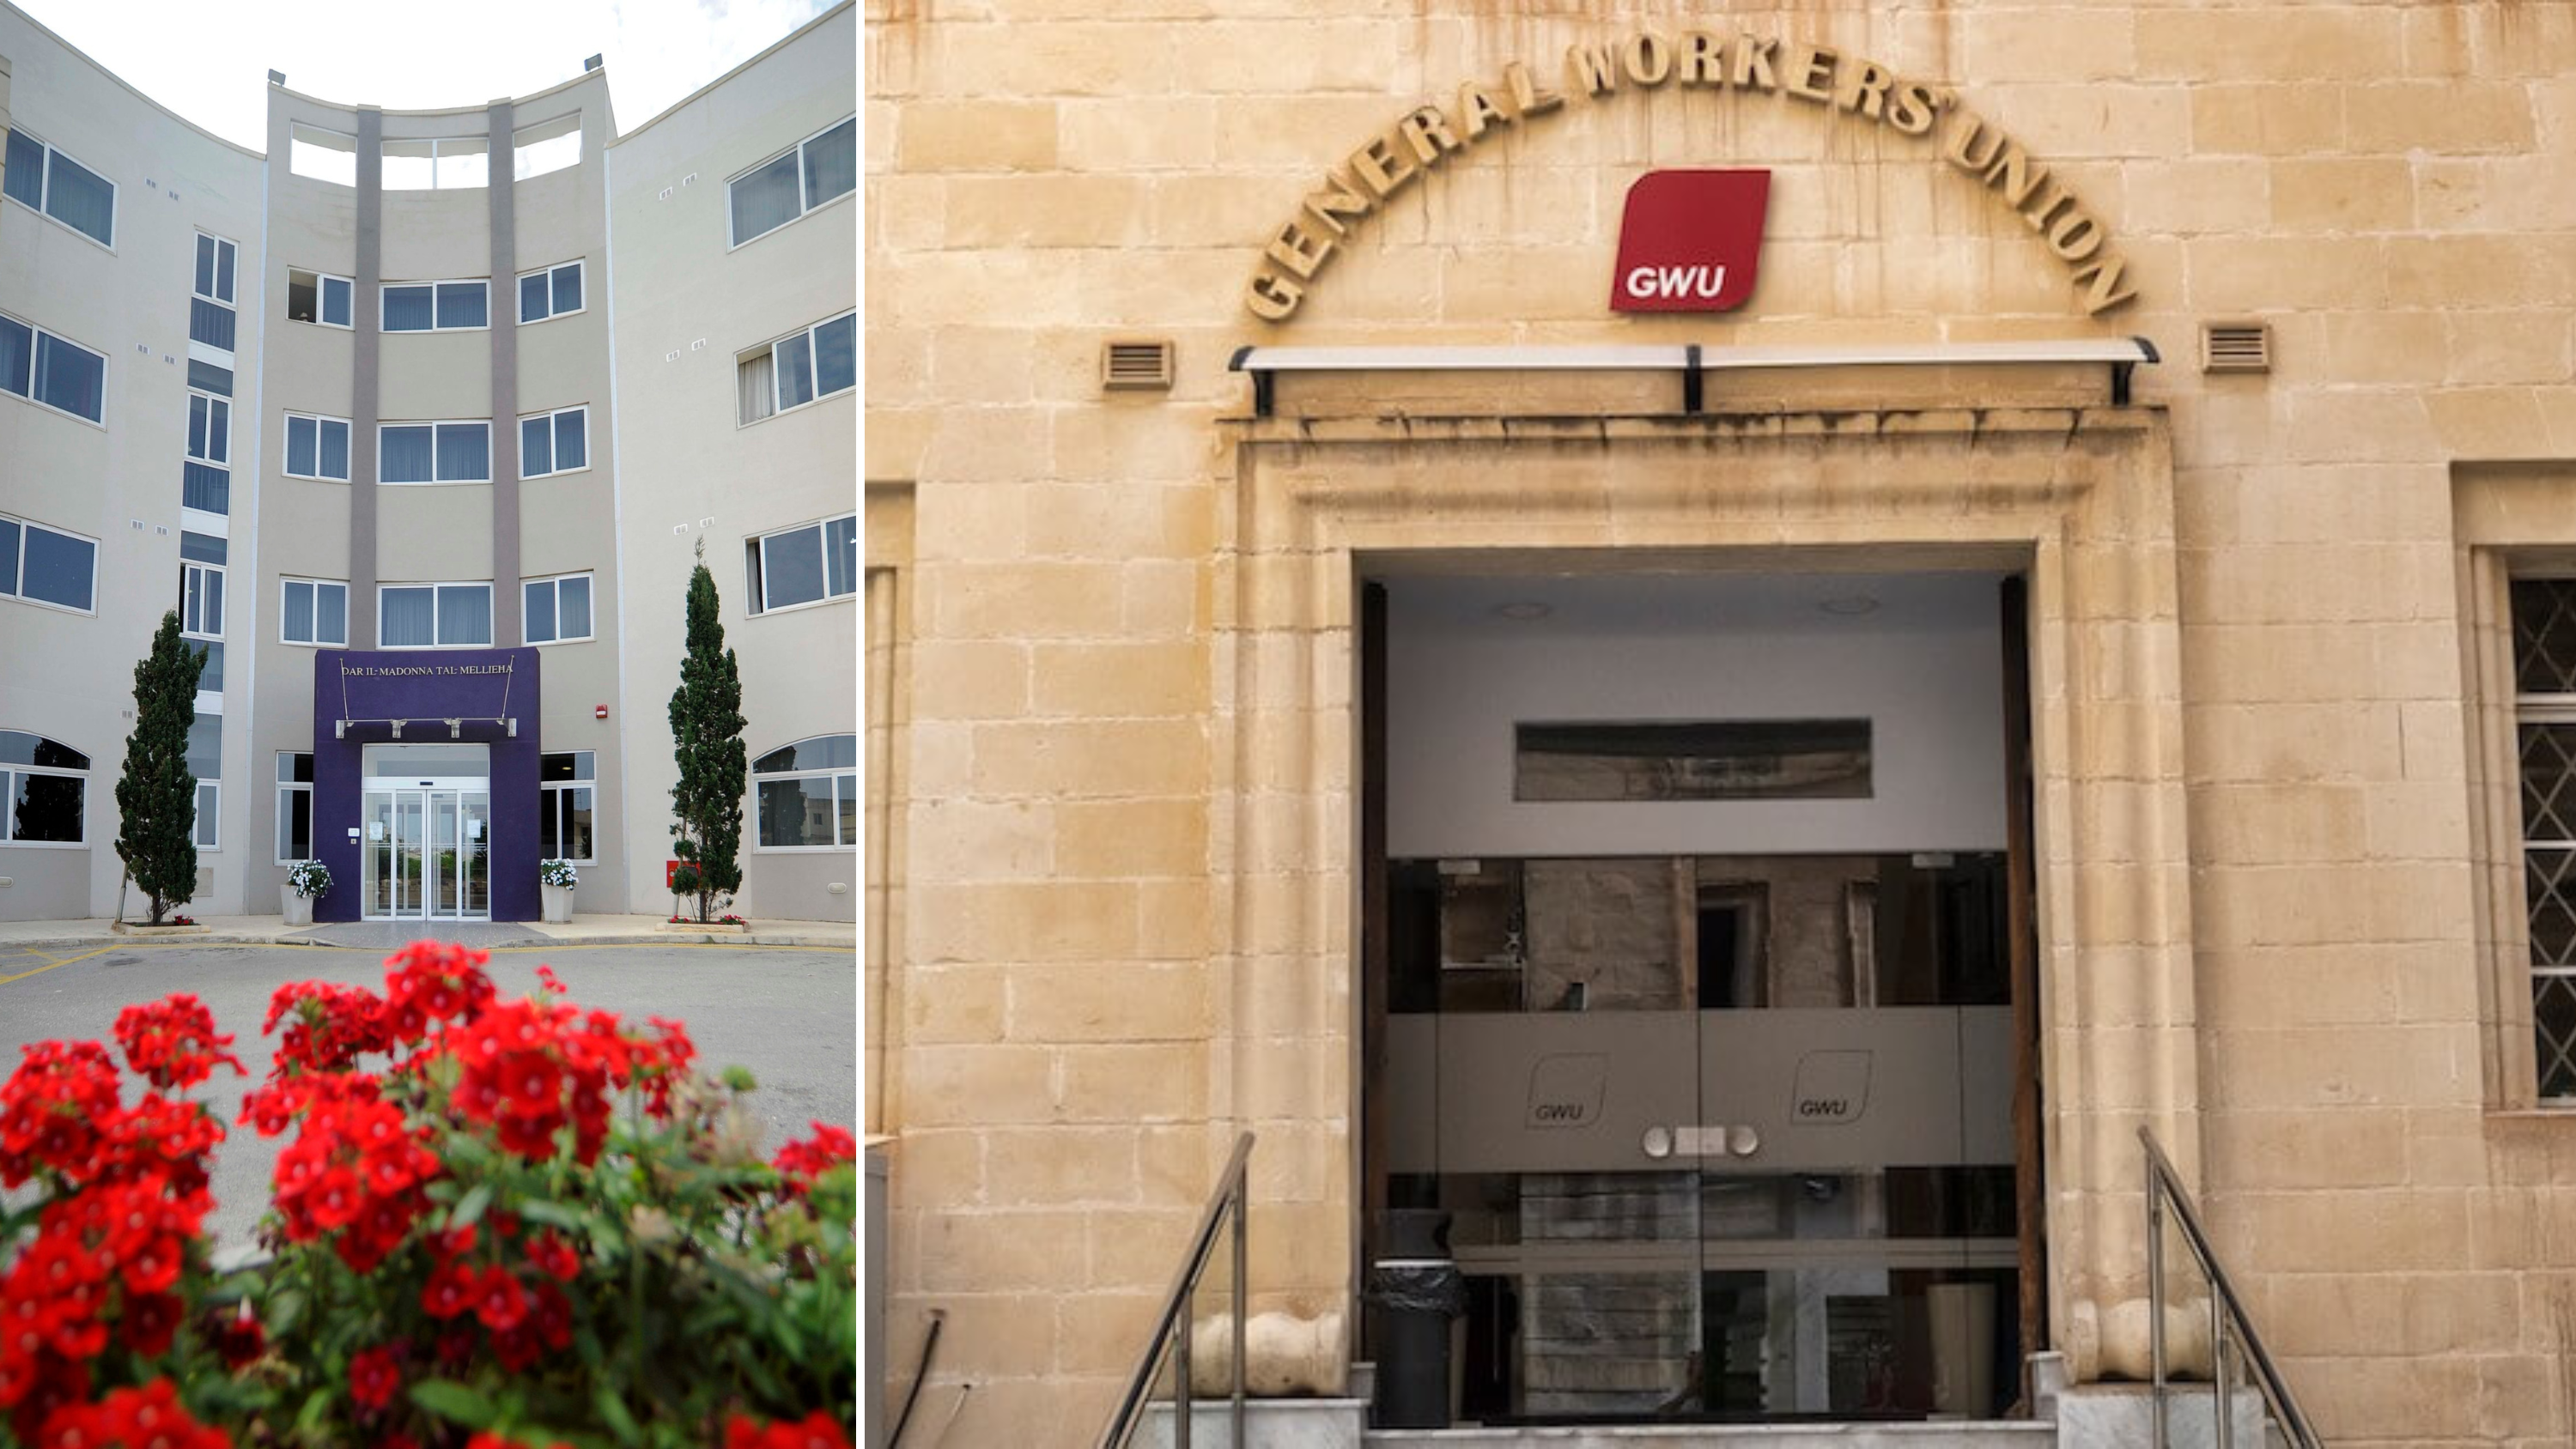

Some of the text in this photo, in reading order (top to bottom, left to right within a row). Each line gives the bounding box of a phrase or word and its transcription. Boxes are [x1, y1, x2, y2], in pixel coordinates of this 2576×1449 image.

[1247, 60, 1564, 323] GENERAL
[1946, 112, 2138, 316] UNION
[1627, 265, 1726, 298] GWU
[342, 667, 363, 676] DAR
[380, 666, 434, 676] MADONNA
[1535, 1104, 1584, 1120] GWU
[1801, 1100, 1848, 1117] GWU
